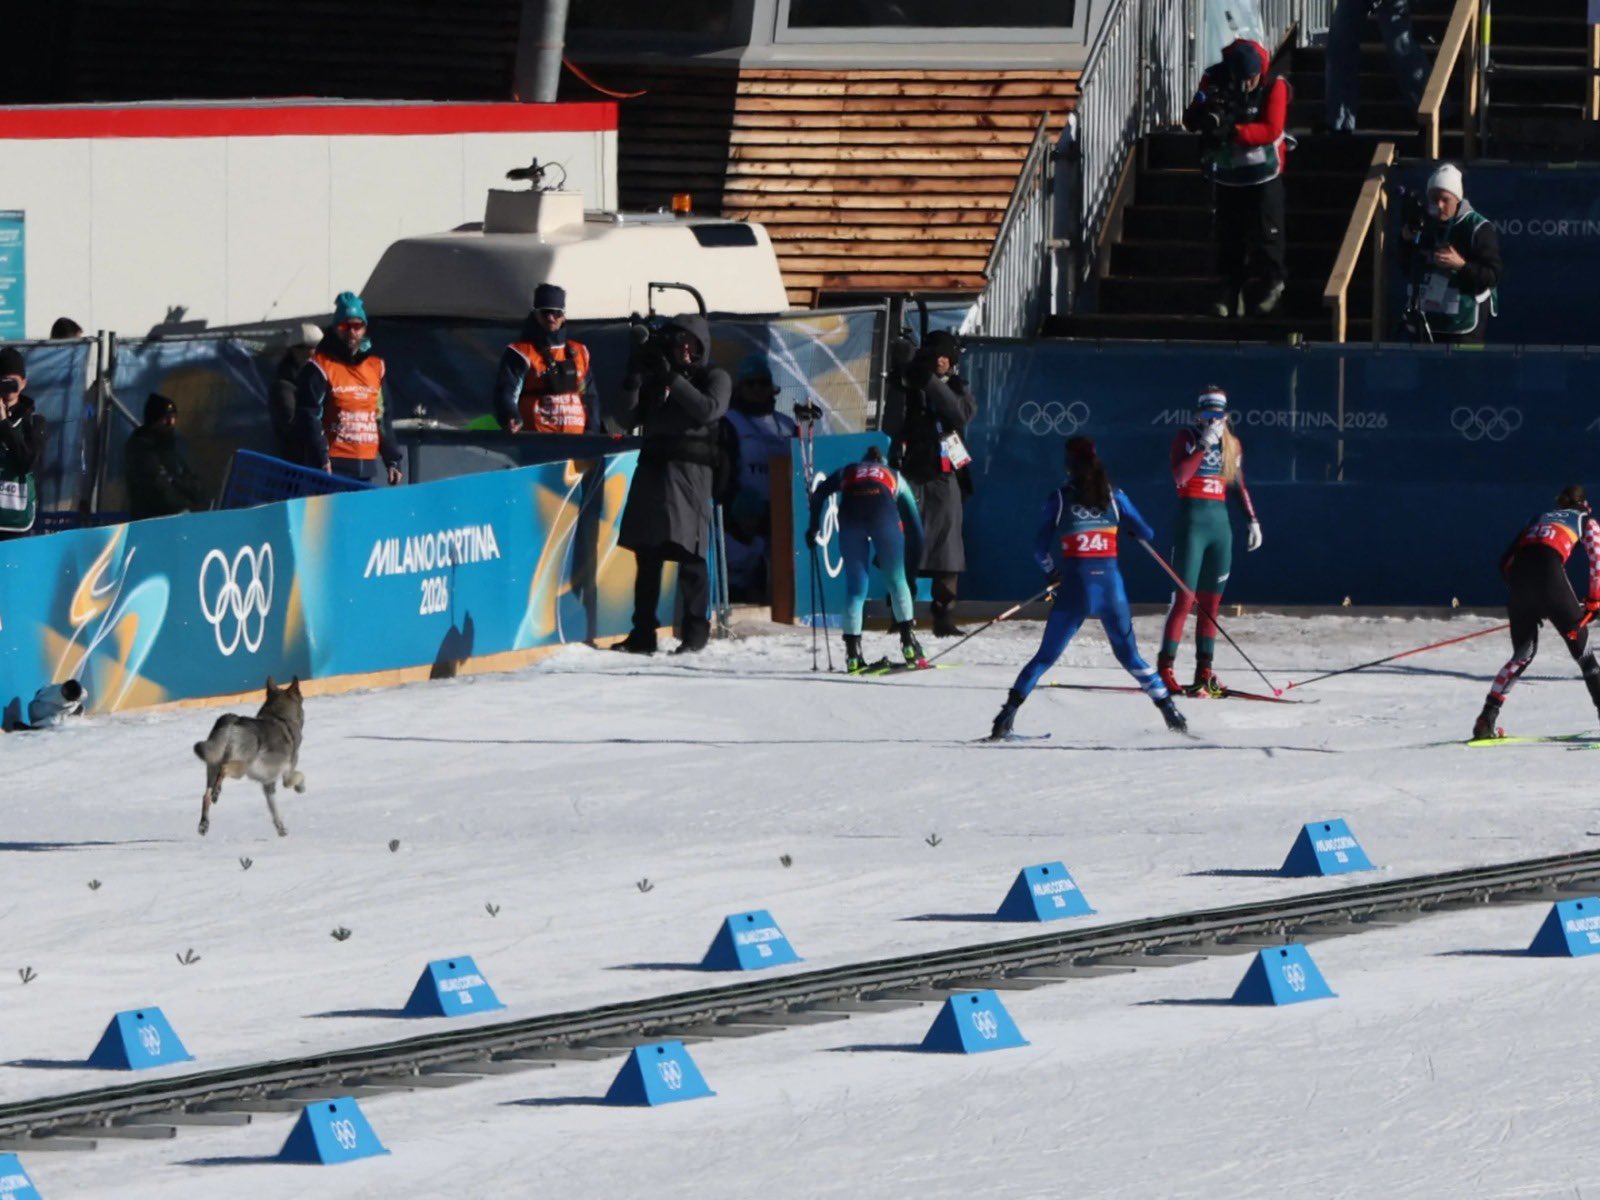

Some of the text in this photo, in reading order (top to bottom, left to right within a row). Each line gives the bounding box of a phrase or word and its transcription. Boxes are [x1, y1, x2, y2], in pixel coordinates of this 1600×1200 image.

[1151, 409, 1388, 428] MILO CORTINA 2026
[364, 523, 500, 578] MILANO CORTINA
[419, 575, 449, 615] 2026
